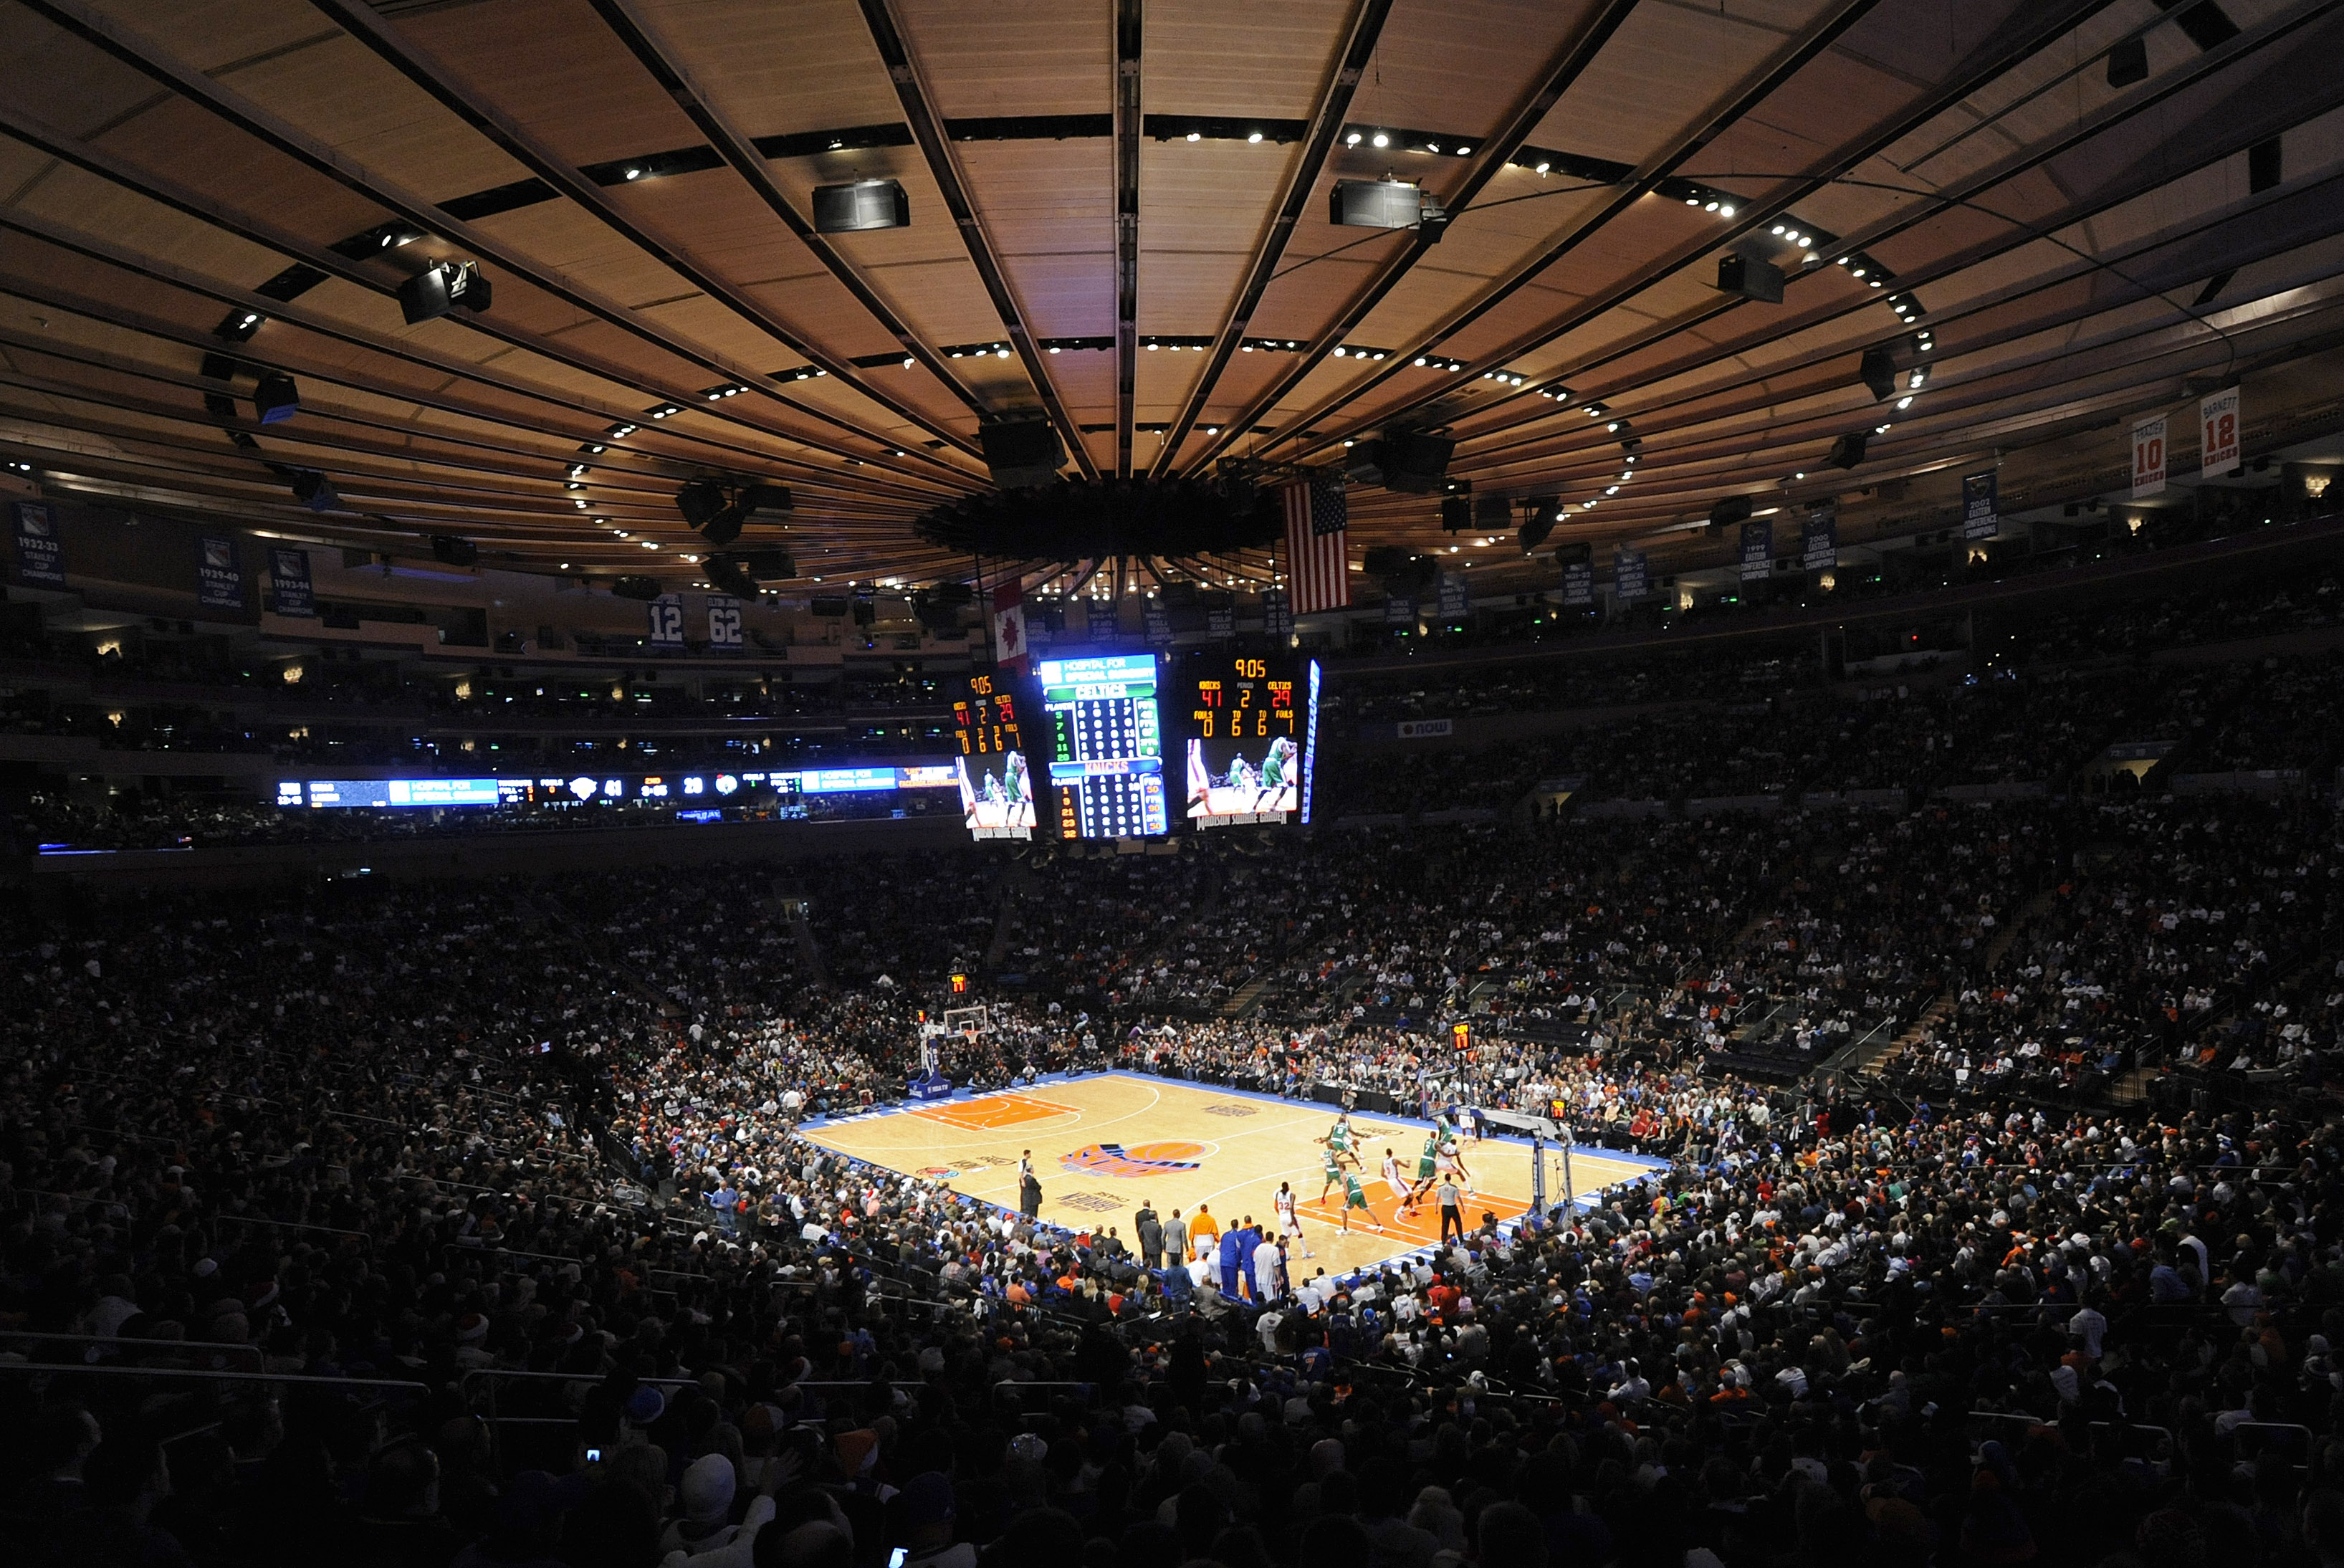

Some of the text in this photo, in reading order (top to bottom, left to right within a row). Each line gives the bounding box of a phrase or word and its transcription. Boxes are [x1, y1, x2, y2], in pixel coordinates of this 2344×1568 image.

[2203, 396, 2237, 419] BARNETT
[2206, 413, 2235, 453] 12
[2137, 439, 2162, 474] 10
[2204, 446, 2238, 467] KNICKS
[2134, 470, 2164, 487] KNICKS
[1970, 498, 1990, 510] 2002
[19, 536, 58, 552] 1932-33
[200, 567, 239, 582] 1939-40
[650, 606, 682, 641] 12
[709, 608, 742, 643] 62
[1106, 658, 1126, 669] FOR
[1235, 659, 1266, 678] 9:05
[1076, 684, 1127, 700] CELTICS
[1199, 681, 1221, 690] KNICKS
[1268, 681, 1292, 690] CELTICS
[1202, 689, 1291, 708] 41 2 29
[957, 710, 970, 725] 41
[980, 707, 987, 724] 2
[1000, 703, 1014, 722] 29
[1124, 707, 1132, 715] 7
[1194, 709, 1293, 720] FOULS TO TO FOULS
[1203, 717, 1293, 737] 0 6 6 1
[1415, 722, 1448, 735] now
[962, 732, 1020, 755] 0 6 6 1
[1057, 743, 1068, 752] 11
[1085, 762, 1129, 775] KNICKS
[605, 780, 622, 796] 41
[1063, 786, 1068, 795] 1
[1061, 808, 1073, 816] 21
[1132, 804, 1139, 813] 7
[1062, 818, 1076, 827] 23
[1149, 822, 1161, 831] 50
[1196, 810, 1288, 831] MADISON SQUARE GARDEN
[1063, 829, 1076, 838] 32
[954, 982, 964, 993] 17
[1453, 1024, 1468, 1034] 9:04
[1456, 1033, 1468, 1048] 17
[824, 1080, 1067, 1126] NEW YORK KNICKS
[1279, 1202, 1291, 1210] 32
